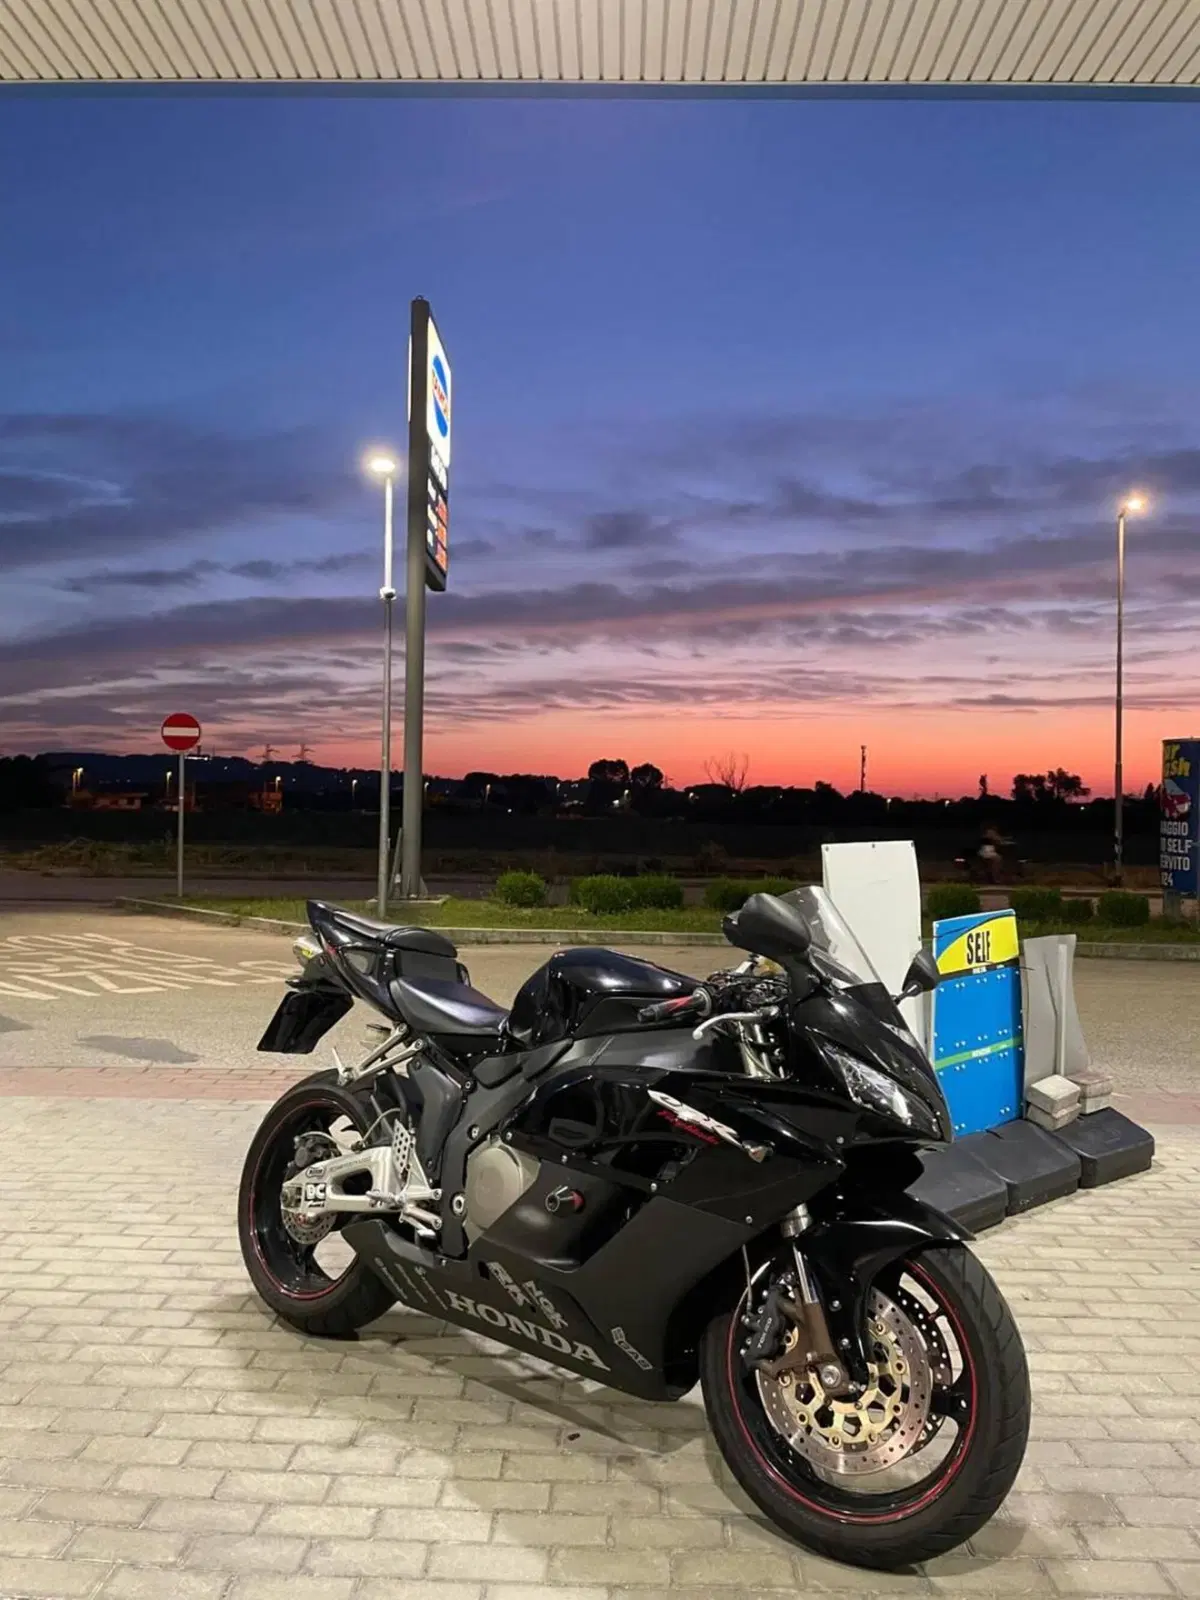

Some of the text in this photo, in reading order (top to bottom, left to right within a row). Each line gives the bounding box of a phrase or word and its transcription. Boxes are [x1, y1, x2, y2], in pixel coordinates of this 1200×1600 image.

[1167, 838, 1193, 854] SELF
[966, 930, 990, 965] SELF
[444, 1289, 611, 1372] HONDA
